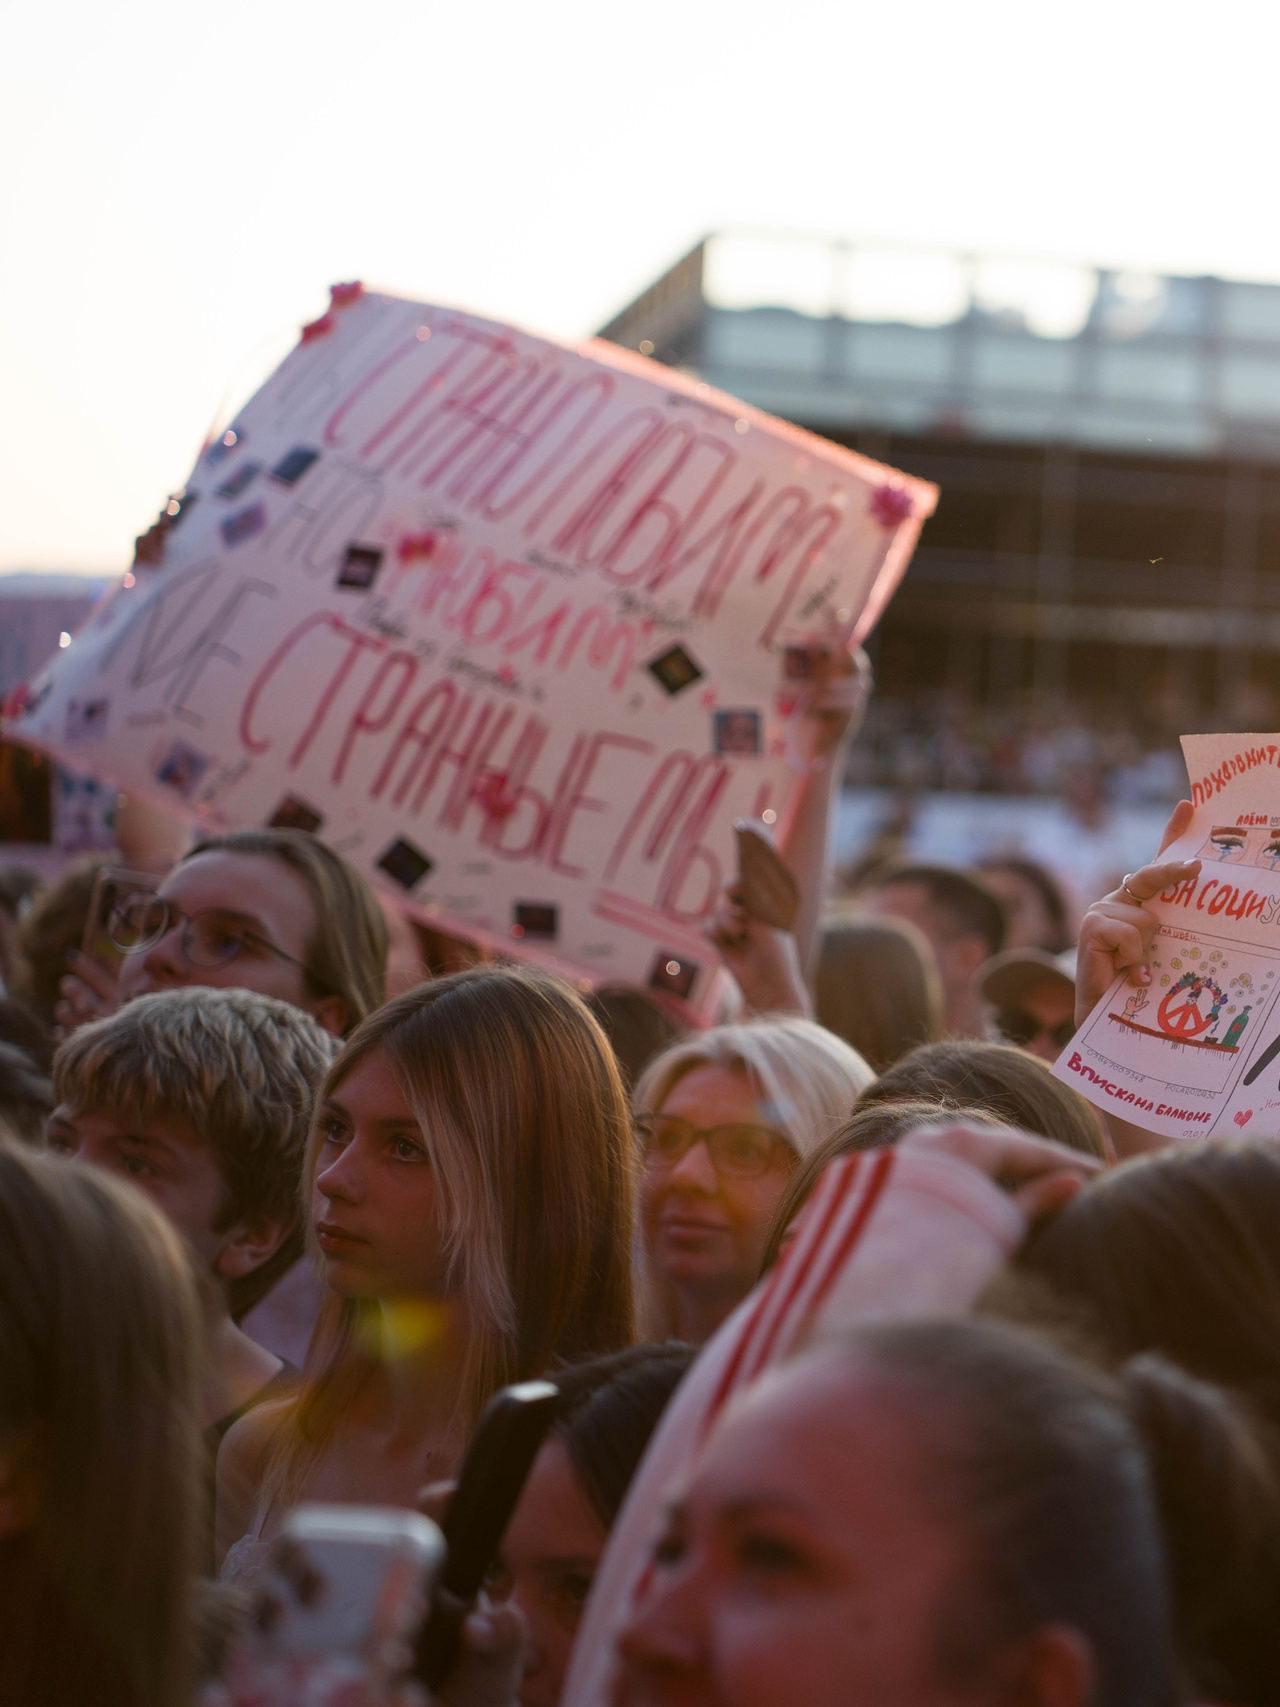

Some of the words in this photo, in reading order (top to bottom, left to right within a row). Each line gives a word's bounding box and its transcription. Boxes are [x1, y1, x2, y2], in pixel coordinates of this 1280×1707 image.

[1236, 811, 1268, 826] АЛЁНА
[1067, 1051, 1135, 1103] ВПИСКА
[1134, 1097, 1153, 1111] НА
[1155, 1104, 1212, 1124] БАЛКОНЕ
